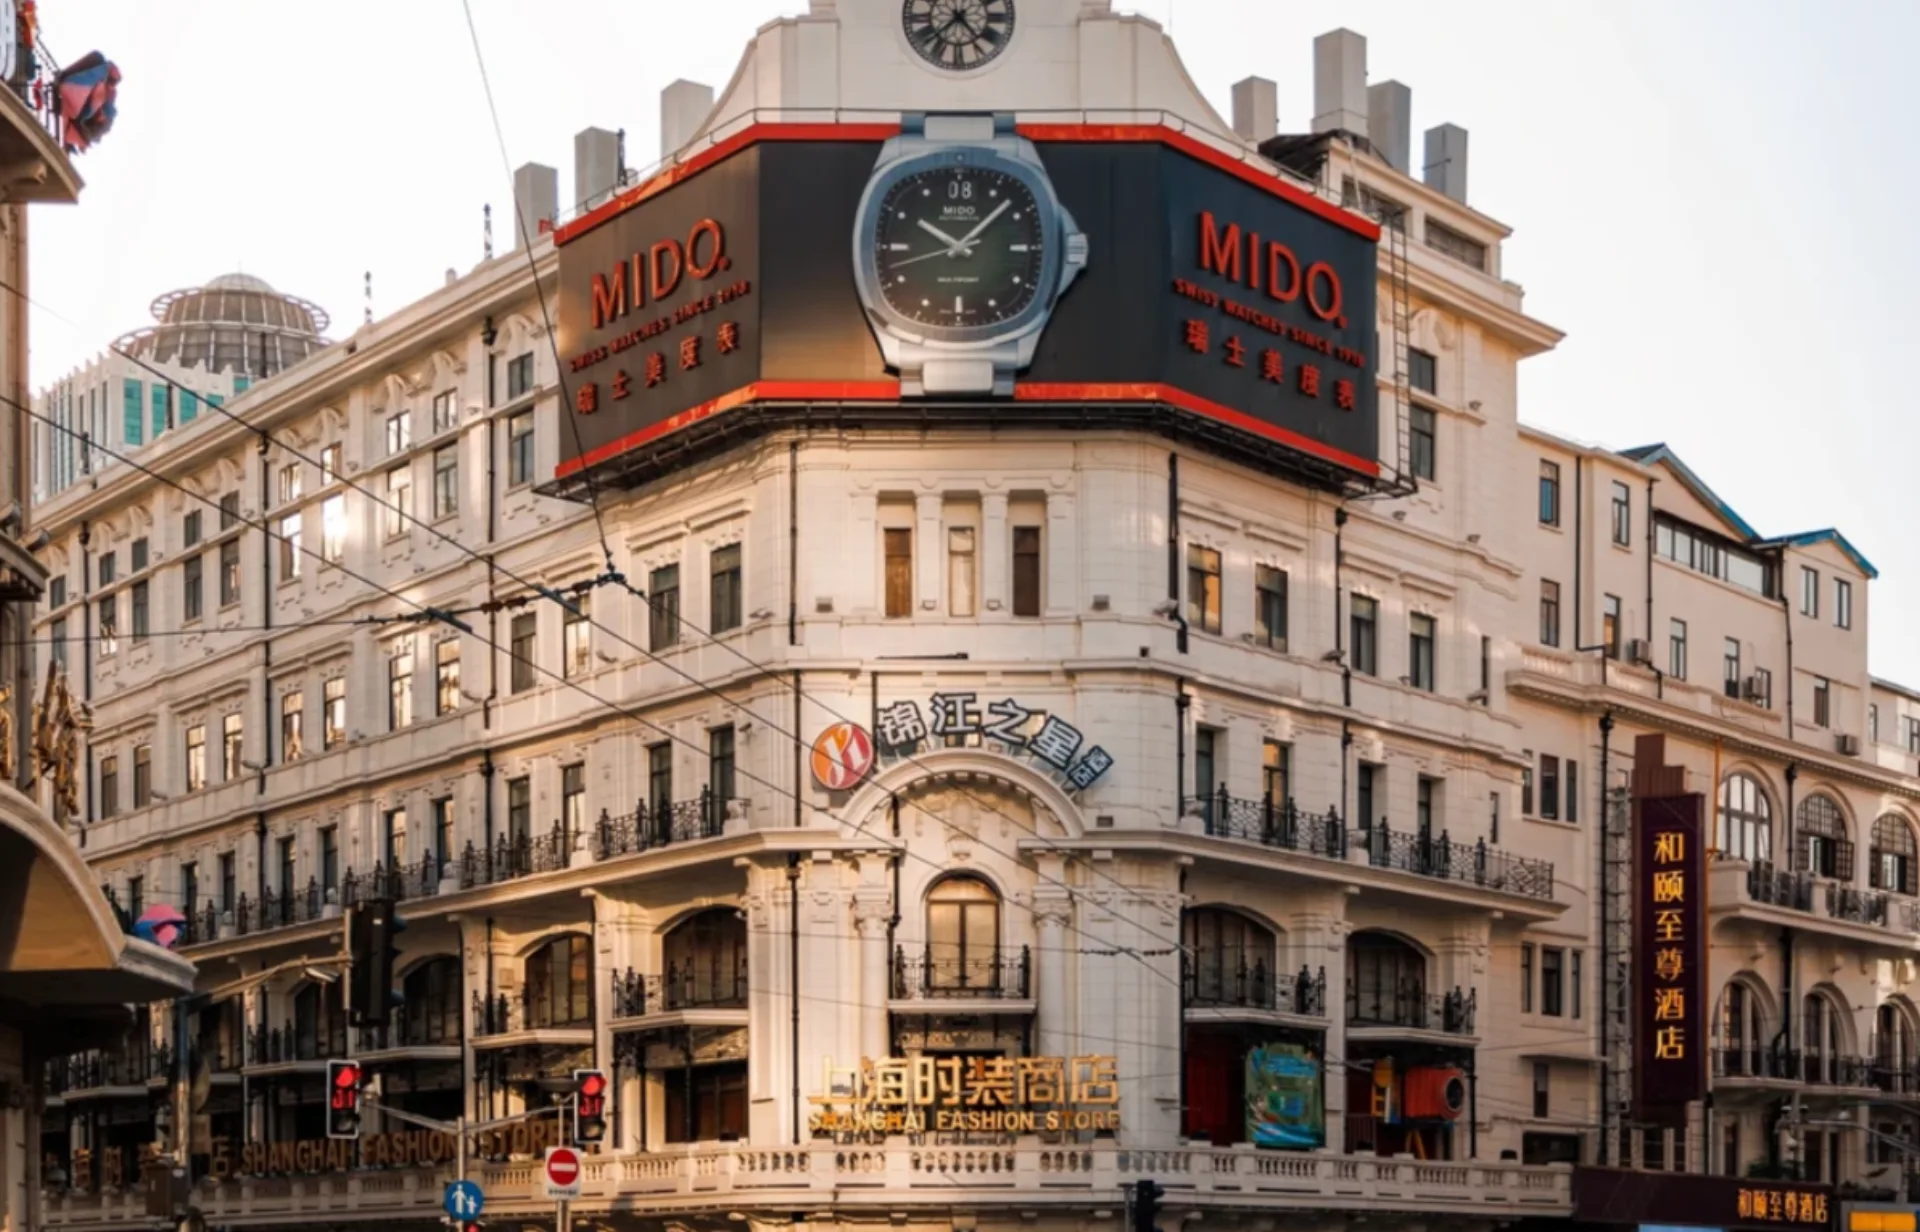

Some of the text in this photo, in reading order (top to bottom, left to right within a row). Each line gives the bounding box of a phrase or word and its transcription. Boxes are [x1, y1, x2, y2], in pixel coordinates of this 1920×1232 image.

[943, 206, 976, 215] MIDO
[948, 181, 972, 199] 08
[591, 218, 724, 329] MIDO
[1200, 211, 1342, 321] MIDO
[673, 295, 714, 325] SINCE
[1173, 278, 1219, 307] SWISS
[1224, 299, 1288, 335] WATCHES
[1290, 326, 1334, 355] SINCE
[1186, 318, 1356, 411] 瑞士美度表
[876, 692, 1084, 770] 锦江之星
[1653, 831, 1685, 1061] 和颐至尊酒店
[807, 1054, 1120, 1106] 上海时装商店
[241, 1138, 348, 1176] SHANGHAI
[362, 1129, 459, 1164] FASHION
[808, 1109, 1120, 1132] SHANGHAI FASHION STORE
